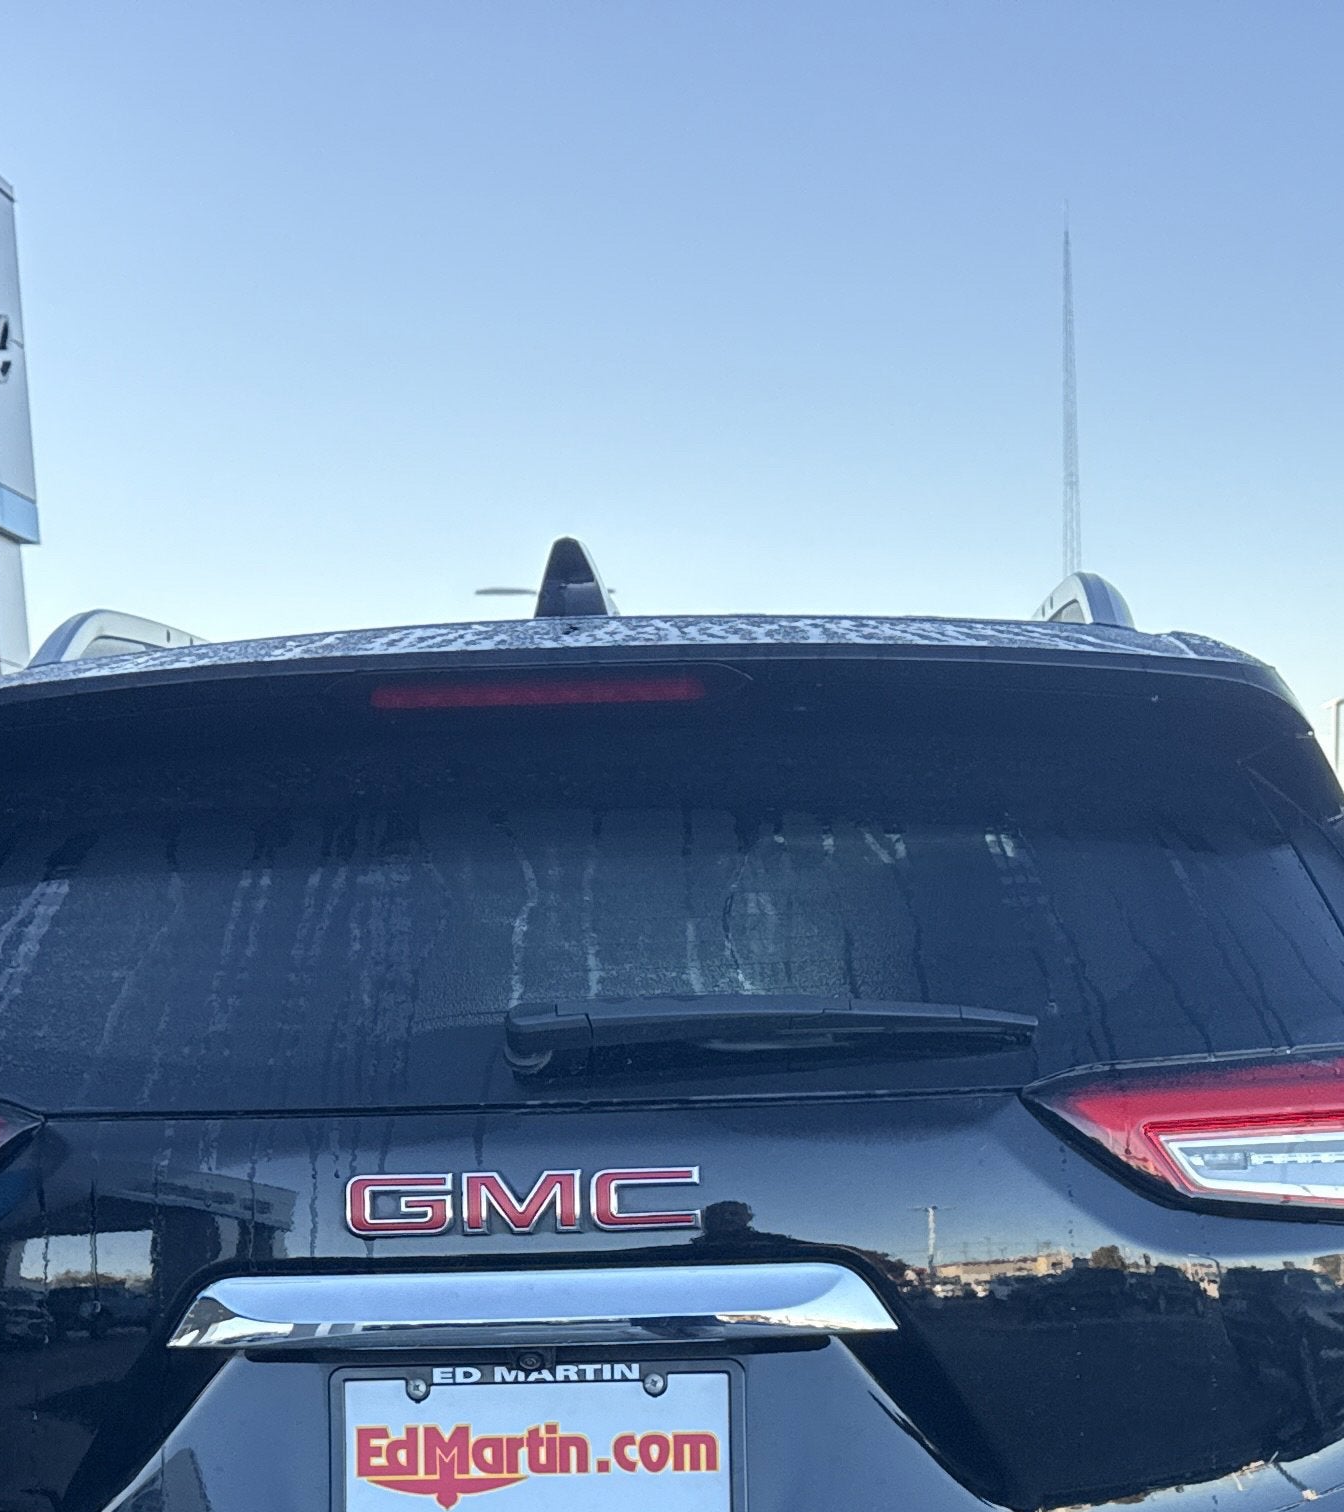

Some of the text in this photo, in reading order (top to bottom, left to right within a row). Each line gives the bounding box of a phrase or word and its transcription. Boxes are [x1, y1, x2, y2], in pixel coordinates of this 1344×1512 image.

[345, 1166, 701, 1235] GMC
[432, 1363, 641, 1384] ED MARTIN
[355, 1422, 720, 1506] EdMartin.com
